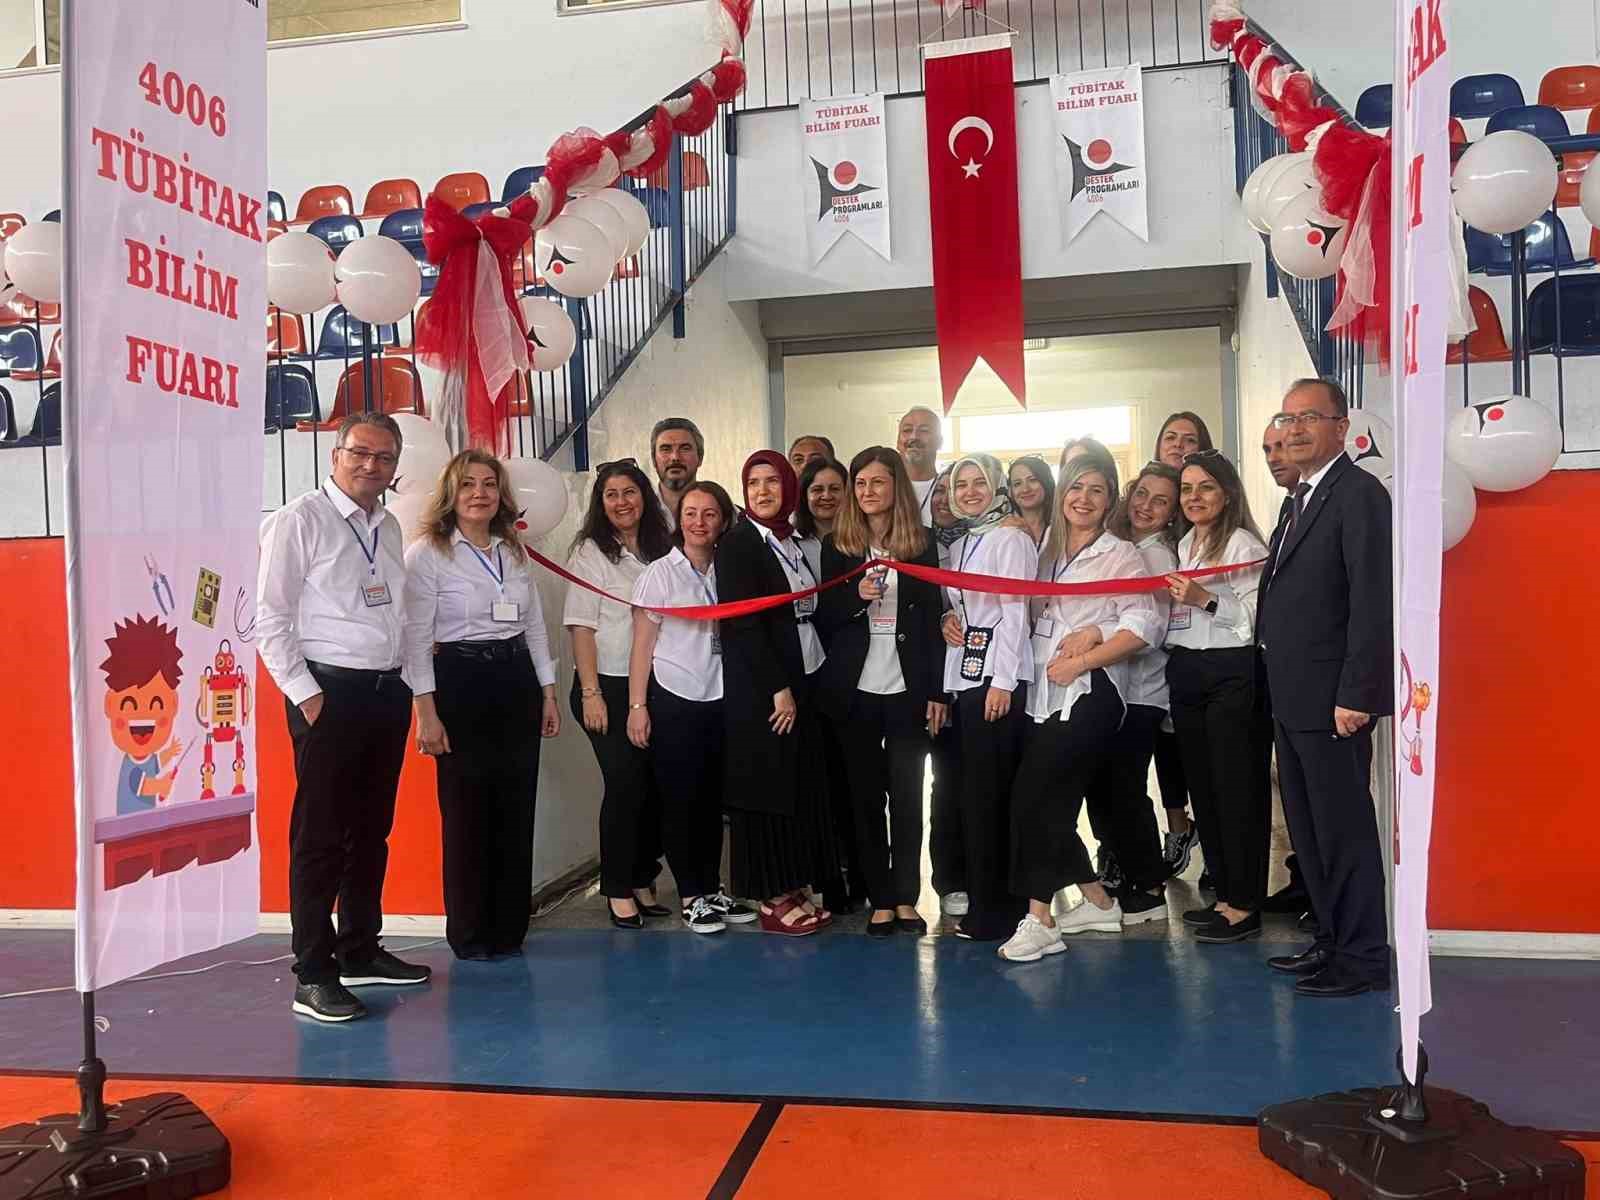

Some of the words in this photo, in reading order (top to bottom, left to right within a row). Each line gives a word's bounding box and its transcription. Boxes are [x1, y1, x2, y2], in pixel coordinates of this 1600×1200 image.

[1068, 80, 1125, 96] TÜBİTAK
[138, 61, 227, 138] 4006
[1099, 93, 1137, 106] FUARI
[816, 104, 869, 119] TÜBİTAK
[845, 116, 880, 128] FUARI
[91, 126, 262, 243] TÜBİTAK
[1086, 180, 1139, 194] PROGRAMLARI
[832, 200, 882, 214] PROGRAMLARI
[124, 234, 239, 321] BİLİM
[126, 334, 240, 409] FUARI
